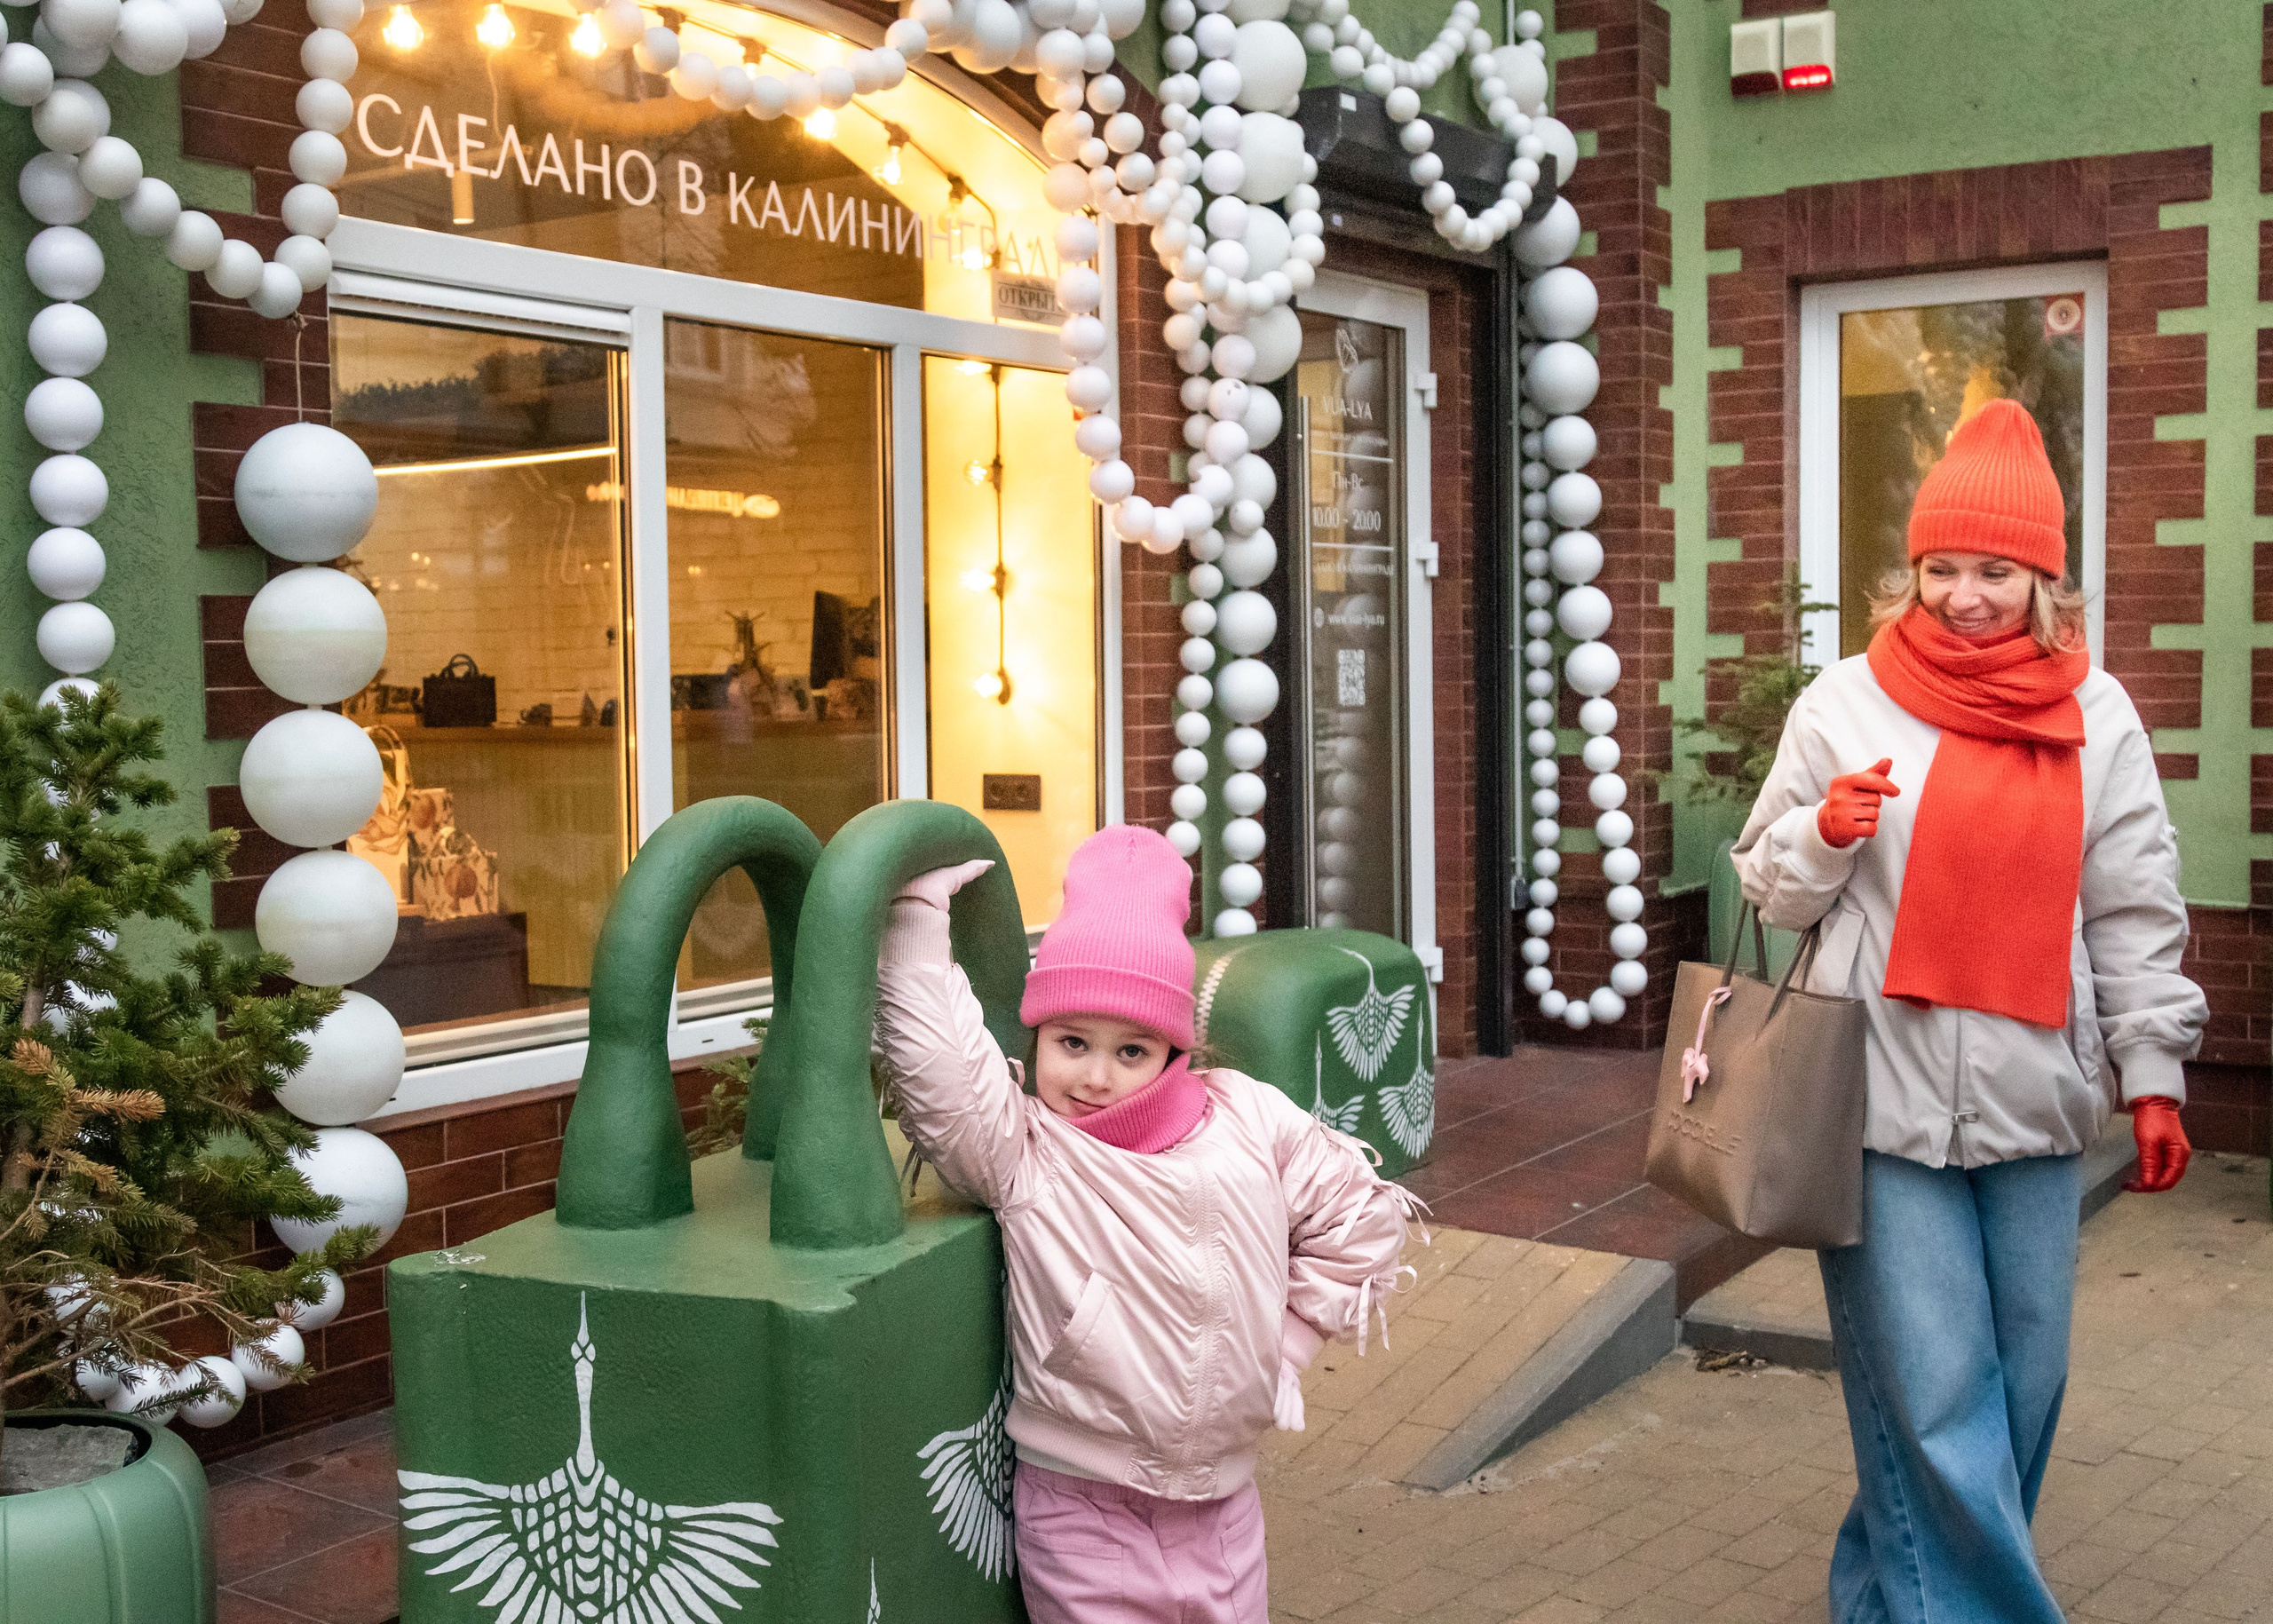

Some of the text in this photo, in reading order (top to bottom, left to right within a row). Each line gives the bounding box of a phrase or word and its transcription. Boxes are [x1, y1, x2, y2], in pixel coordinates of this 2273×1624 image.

[357, 93, 1062, 278] СДЕЛАНО В КАЛИНИНГРАД
[998, 284, 1063, 312] ОТКРЫТ
